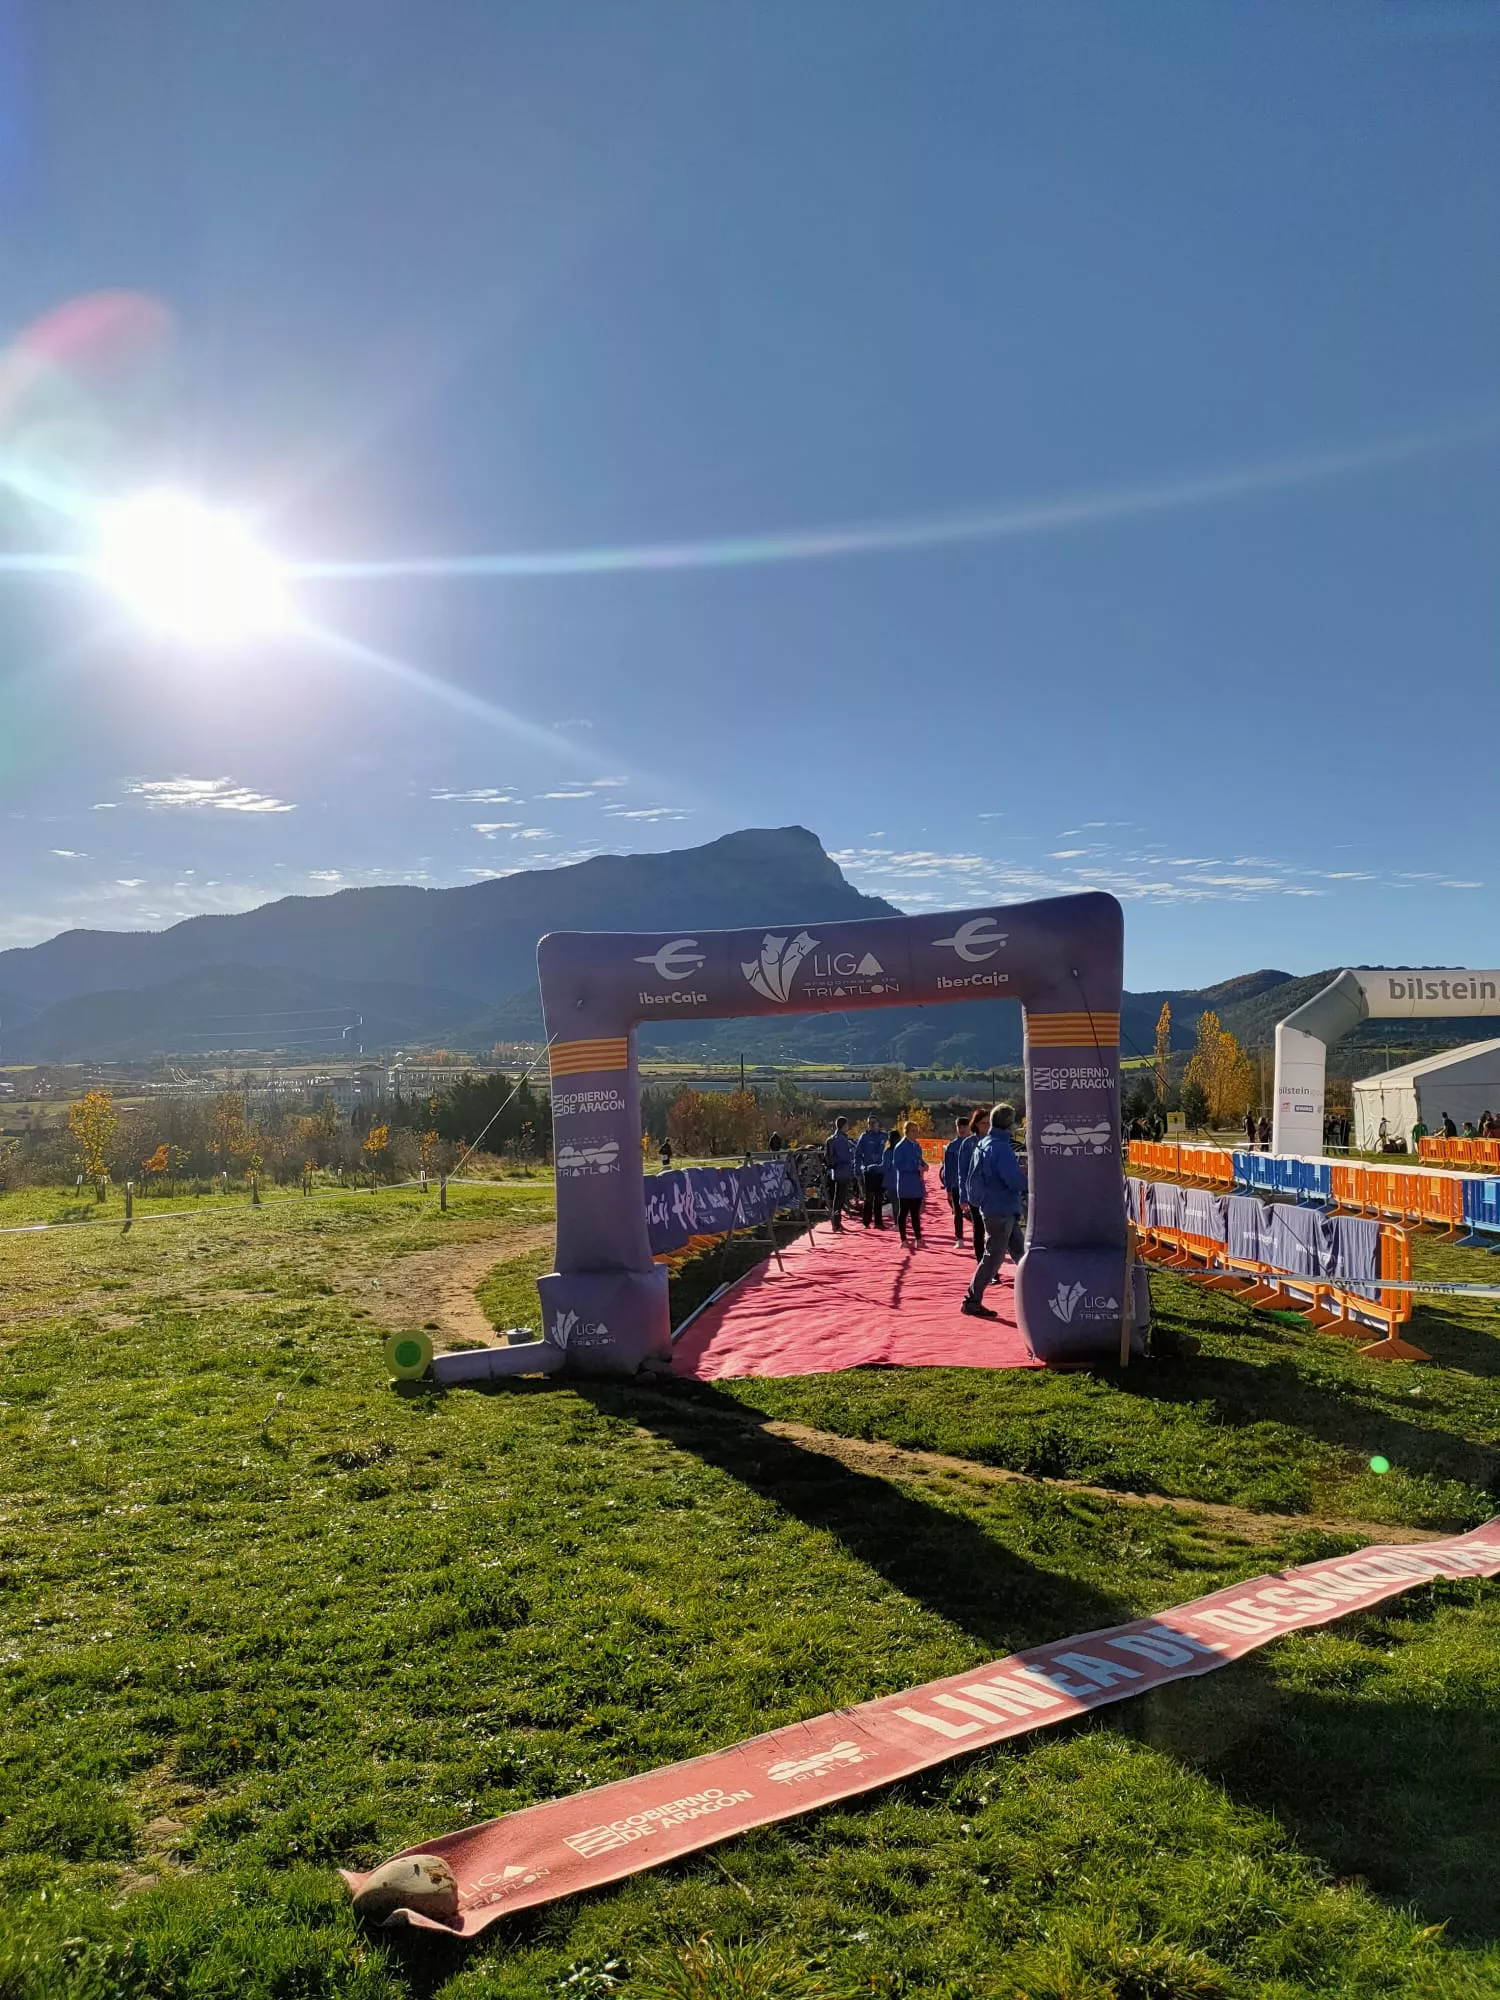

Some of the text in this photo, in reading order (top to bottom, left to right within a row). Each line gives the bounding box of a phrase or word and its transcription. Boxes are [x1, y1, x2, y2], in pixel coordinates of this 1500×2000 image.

[814, 952, 884, 976] LIGA
[937, 970, 1009, 989] iberCaja
[802, 983, 900, 997] TRIATLON
[1388, 978, 1496, 1000] bilstein
[638, 991, 707, 1005] iberCaja
[1051, 1067, 1109, 1079] GOBIERNO
[1051, 1078, 1115, 1090] DE ARAGON
[563, 1090, 618, 1104] GOBIERNO
[563, 1100, 625, 1115] DE ARAGON
[1040, 1145, 1112, 1156] TRIATLON
[559, 1164, 620, 1177] TRIATLON
[1084, 1296, 1119, 1309] LIGA
[576, 1322, 609, 1335] LIGA
[891, 1652, 1144, 1740] LINEA
[1105, 1624, 1231, 1668] DE
[778, 1750, 880, 1786] TRIATLON
[610, 1788, 724, 1831] GOBIERNO
[621, 1789, 755, 1842] DE ARAGON
[458, 1865, 529, 1899] LIGA
